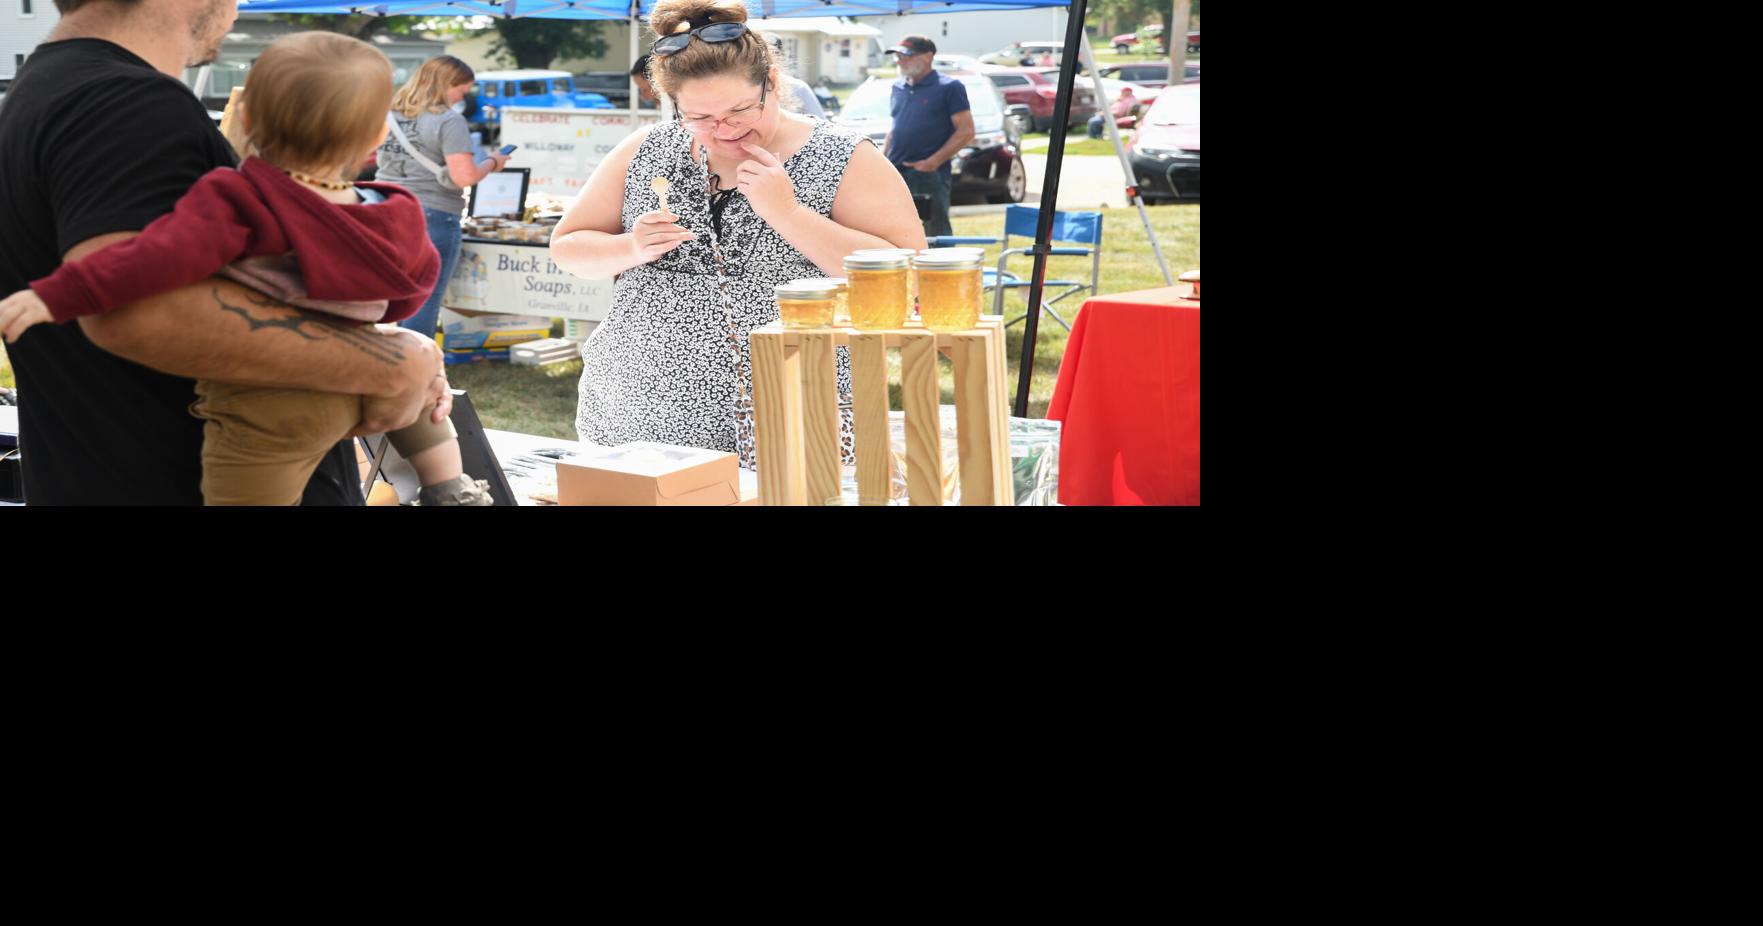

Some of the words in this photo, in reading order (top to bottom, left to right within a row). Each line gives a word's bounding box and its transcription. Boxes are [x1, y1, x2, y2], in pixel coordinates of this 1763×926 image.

[511, 112, 570, 124] CELEBRATE
[576, 128, 592, 138] AT
[496, 253, 541, 274] Buck
[580, 285, 602, 297] LLC
